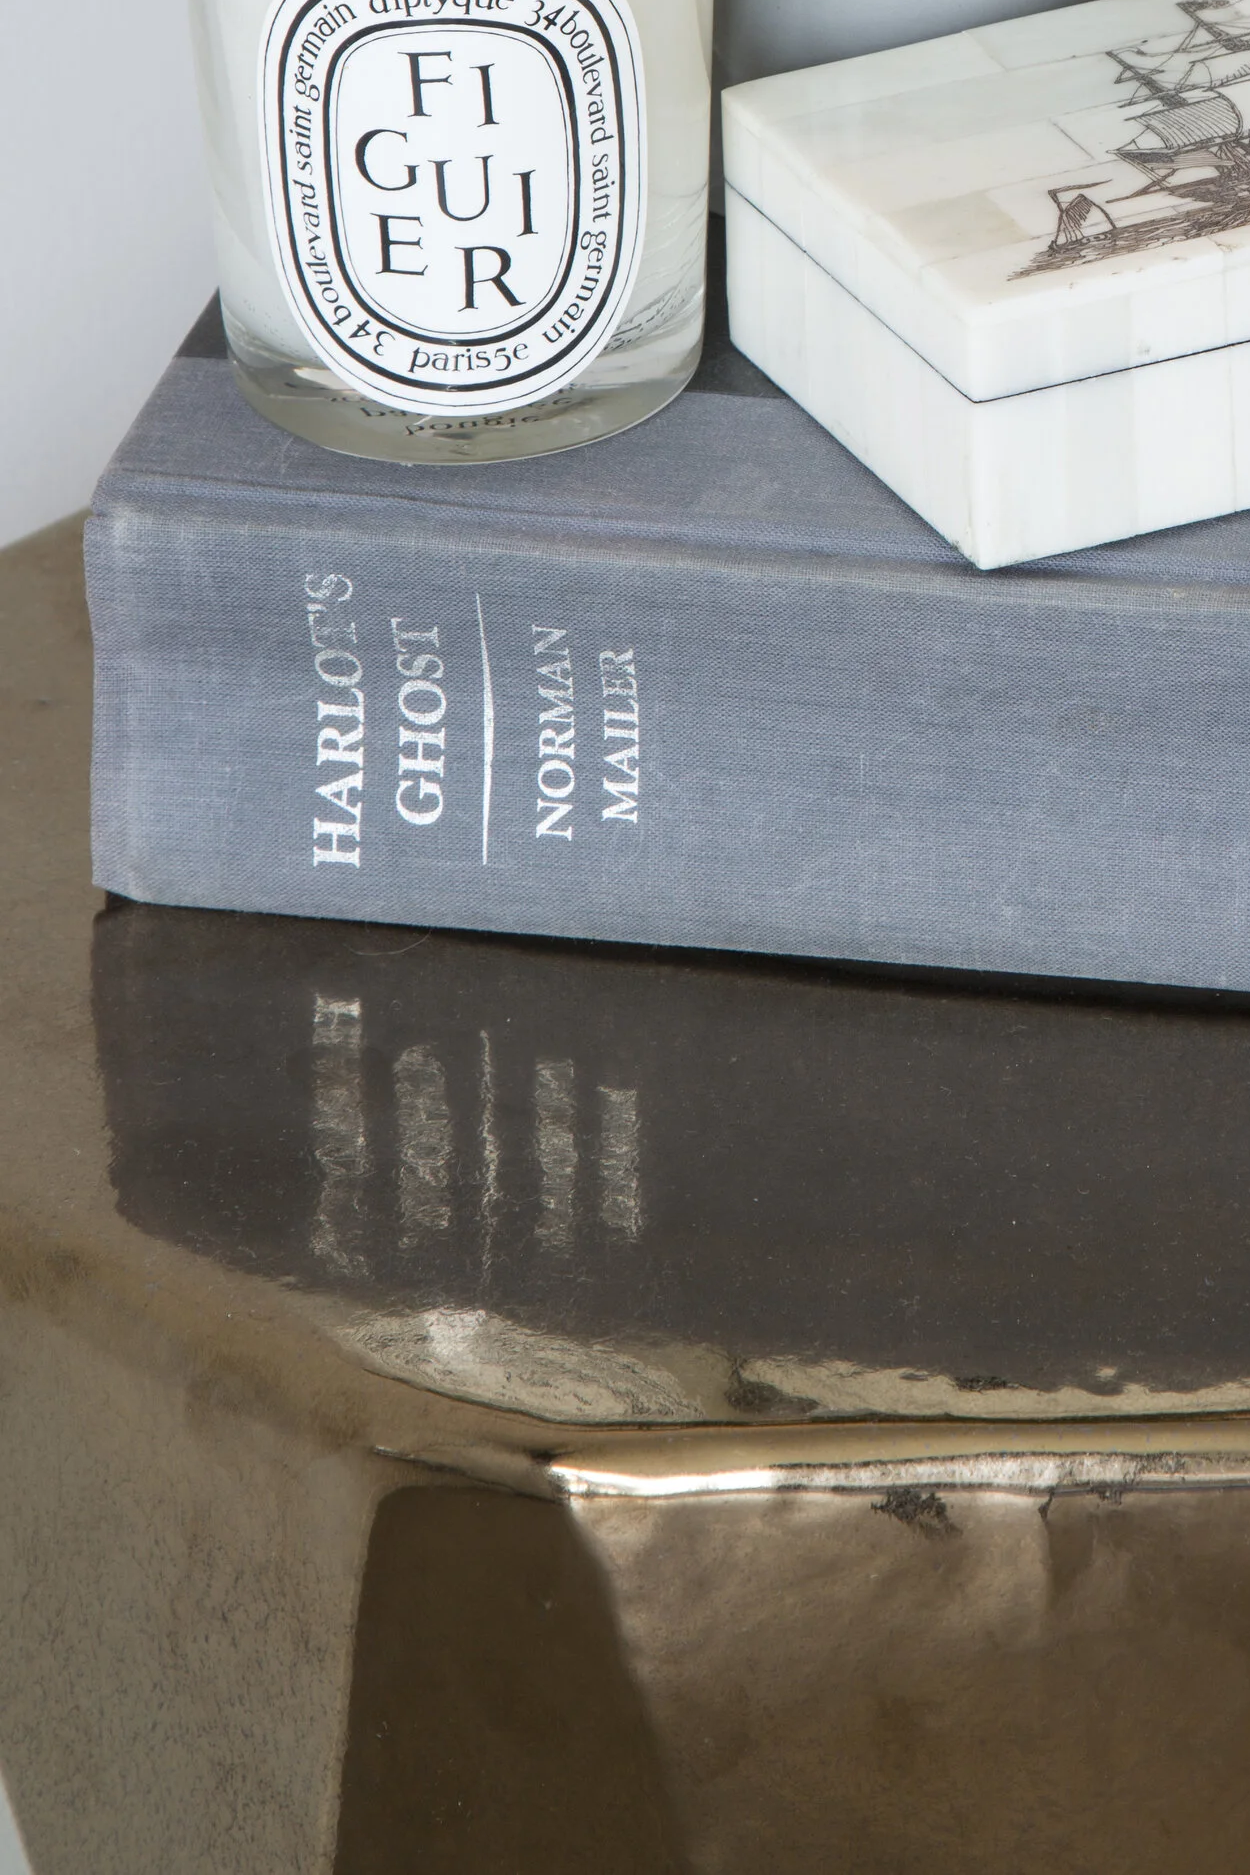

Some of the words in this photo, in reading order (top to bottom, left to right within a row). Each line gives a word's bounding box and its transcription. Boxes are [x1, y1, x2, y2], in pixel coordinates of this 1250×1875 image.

[294, 1, 357, 102] germain
[289, 104, 313, 175] saint
[591, 152, 615, 224] saint
[292, 178, 352, 327] boulevard
[543, 229, 607, 345] germain
[303, 572, 365, 869] HARLOT'S
[390, 617, 447, 826] GHOST
[532, 624, 576, 842] NORMAN
[599, 647, 640, 824] MAILER
